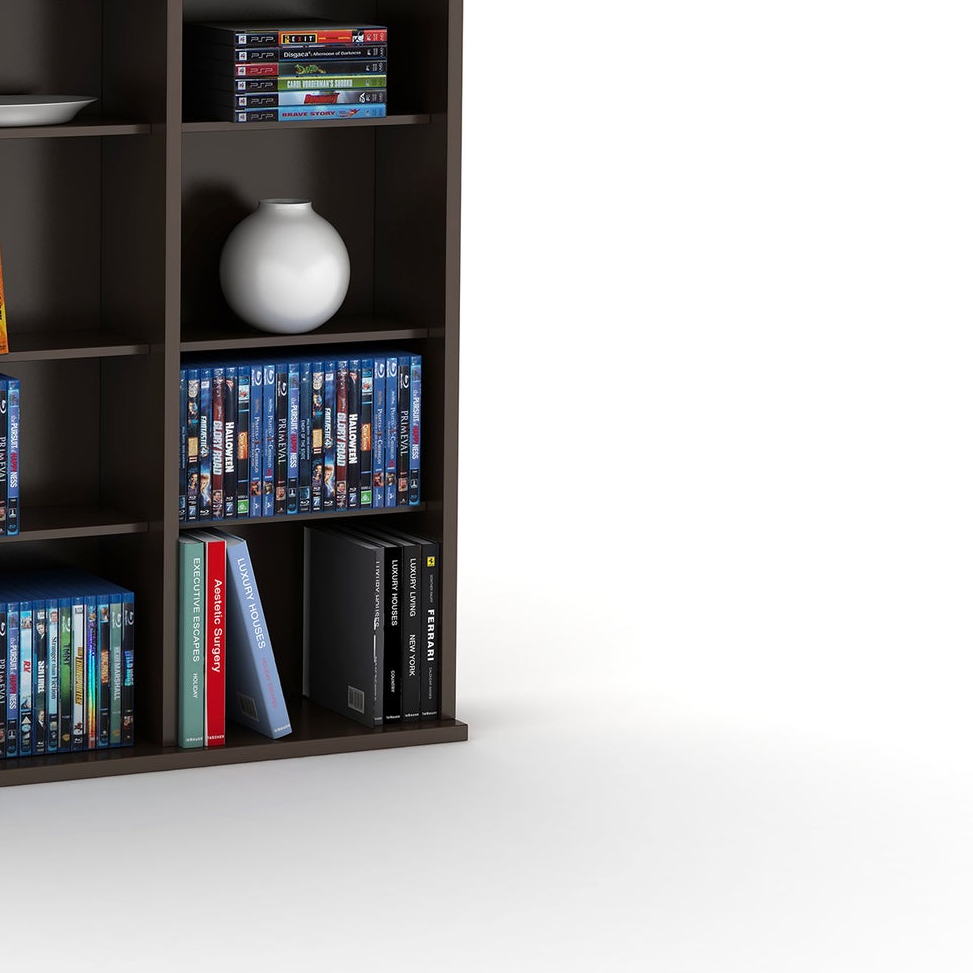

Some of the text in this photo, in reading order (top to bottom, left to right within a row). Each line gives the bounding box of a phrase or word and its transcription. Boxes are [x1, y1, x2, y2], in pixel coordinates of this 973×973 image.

[213, 420, 222, 475] GLORY ROAD
[225, 422, 234, 473] HALLOWEEN
[278, 418, 286, 465] PRIMEVAL
[336, 412, 345, 466] GLORY ROAD
[349, 414, 358, 464] HALLOWEEN
[400, 411, 408, 456] PRIMEVAL
[214, 579, 222, 625] Aestetic
[237, 558, 266, 649] LUXURY HOUSES
[212, 628, 222, 673] Surgery
[427, 609, 435, 661] FERRARI
